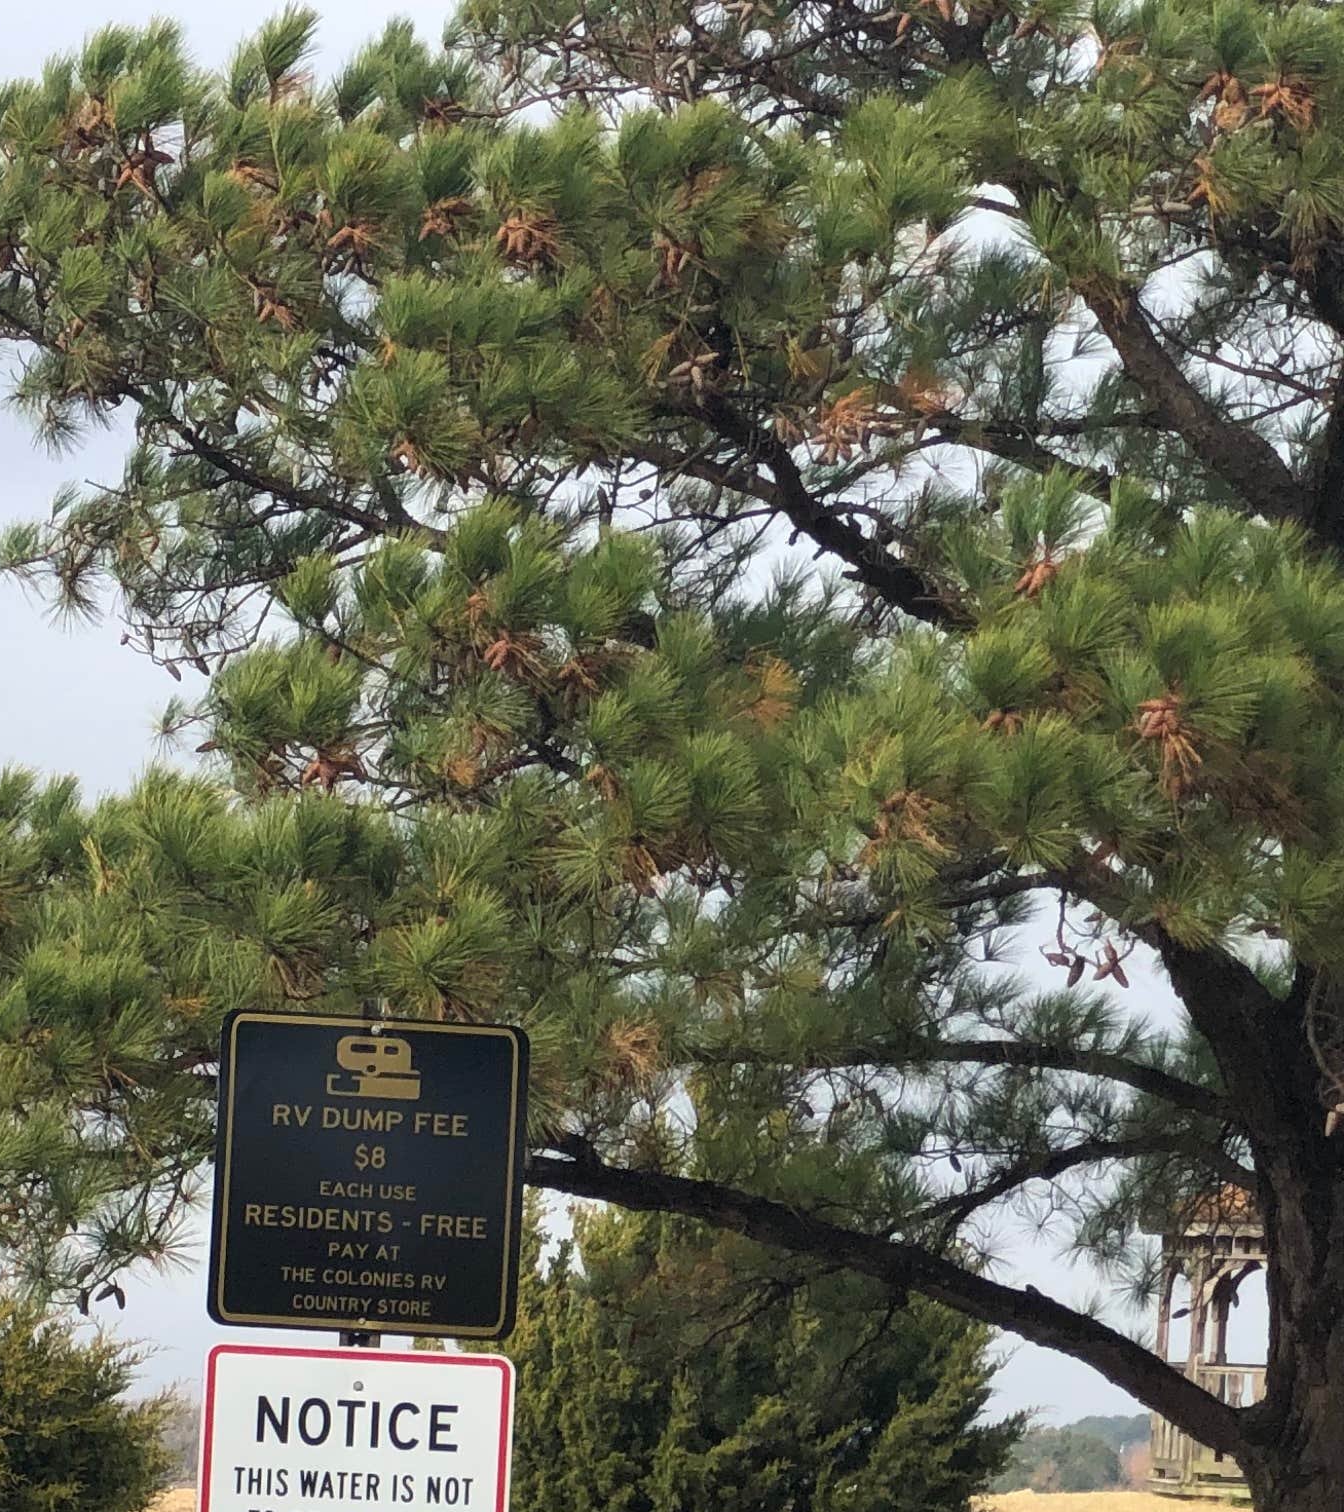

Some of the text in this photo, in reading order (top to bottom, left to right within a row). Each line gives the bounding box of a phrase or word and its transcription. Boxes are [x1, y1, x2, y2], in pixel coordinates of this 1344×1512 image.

[272, 1104, 469, 1137] RV DUMP FEE
[354, 1144, 386, 1171] $8
[319, 1181, 416, 1201] EACH USE
[244, 1203, 393, 1233] RESIDENTS
[420, 1215, 488, 1240] FREE
[328, 1243, 401, 1261] PAY AT
[280, 1266, 447, 1290] THE COLONIES RV
[292, 1294, 432, 1317] COUNTRY STORE
[255, 1395, 459, 1453] NOTICE
[234, 1466, 474, 1506] THIS WATER IS NOT
